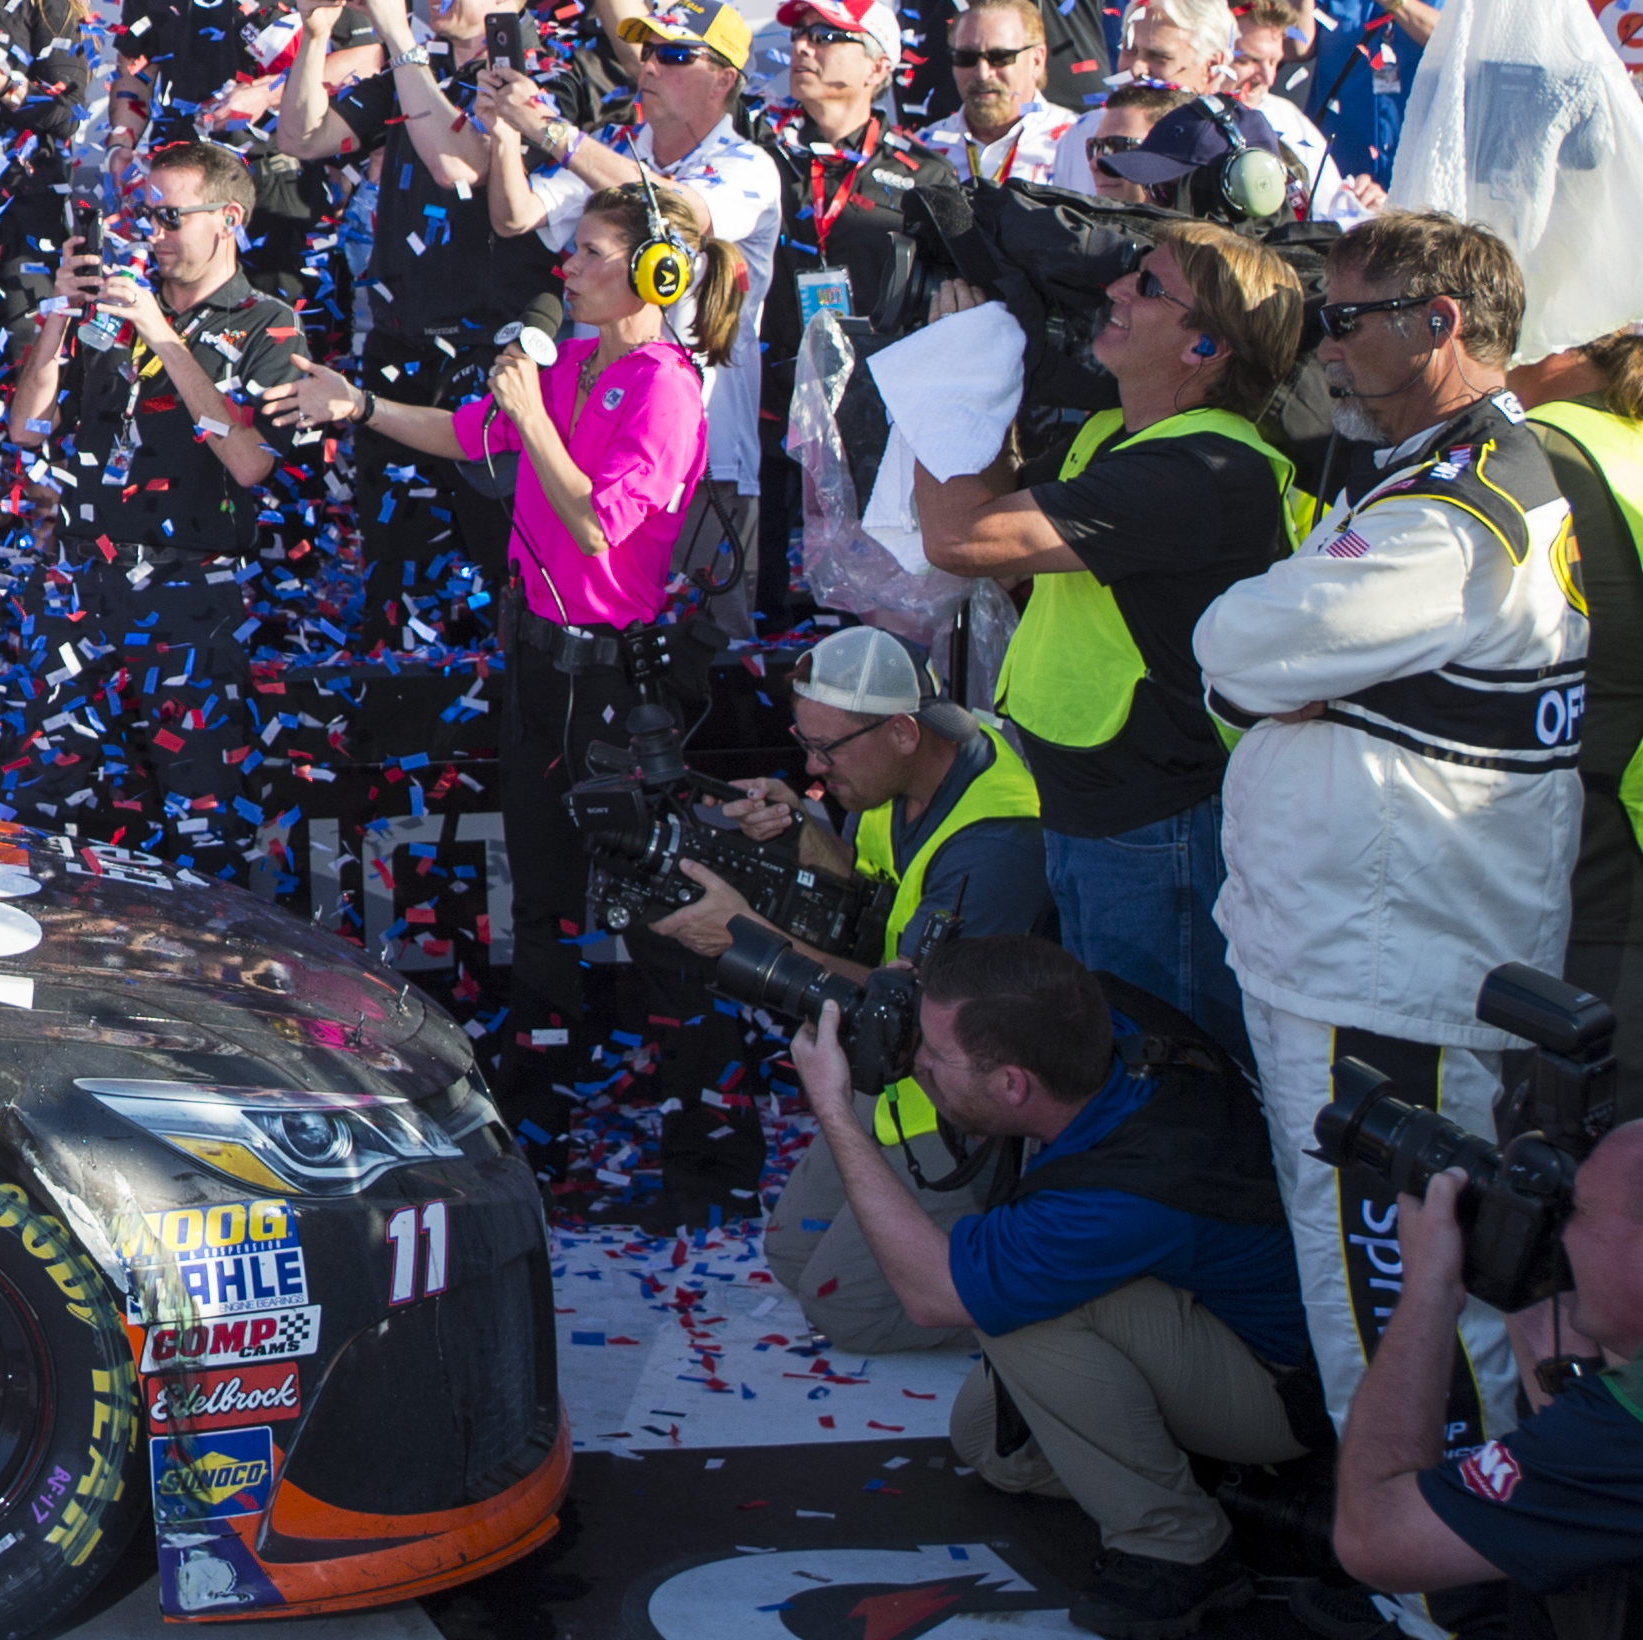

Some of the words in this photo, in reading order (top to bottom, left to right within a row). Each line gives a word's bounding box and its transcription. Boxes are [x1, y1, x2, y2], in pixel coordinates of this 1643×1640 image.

[386, 1198, 449, 1307] 11
[219, 1299, 256, 1314] ENGINE
[256, 1294, 305, 1309] BEARINGS
[151, 1317, 278, 1361] COMP
[238, 1340, 301, 1359] CAMS
[151, 1373, 297, 1421] Edelbrock
[161, 1460, 264, 1495] SUNOCO
